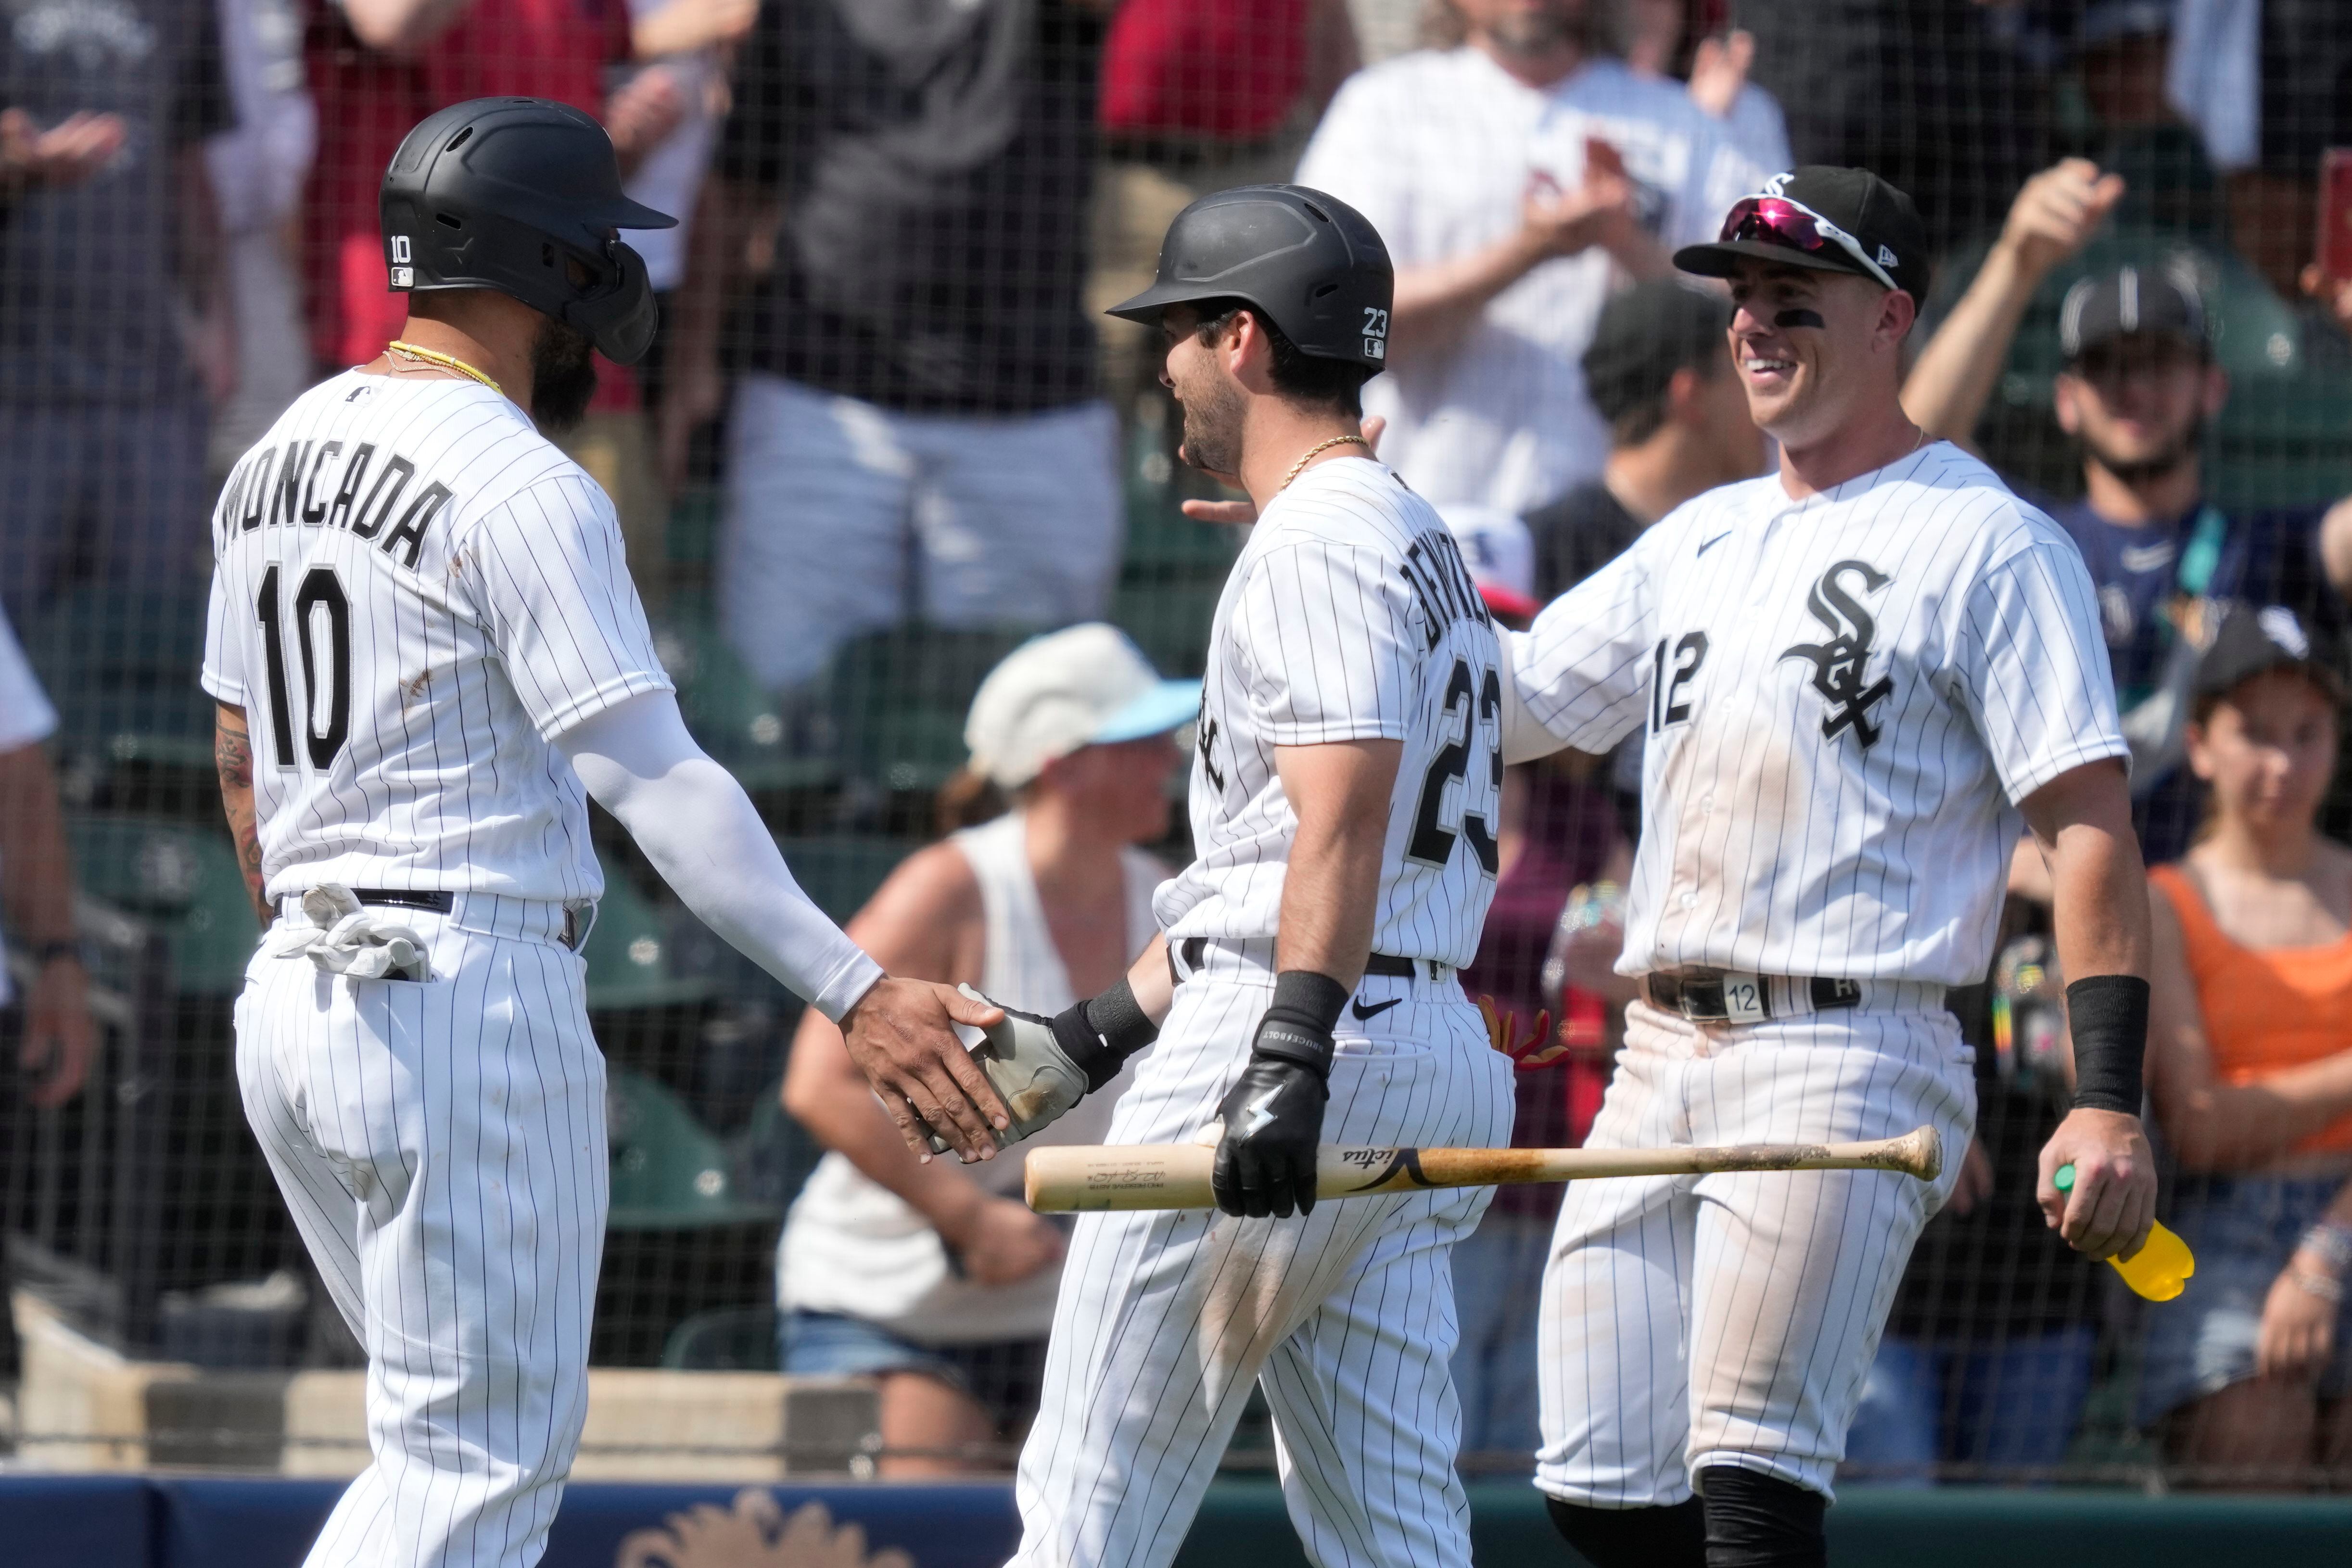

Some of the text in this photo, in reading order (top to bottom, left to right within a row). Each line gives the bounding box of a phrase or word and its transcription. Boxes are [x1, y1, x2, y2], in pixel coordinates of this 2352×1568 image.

[391, 235, 411, 263] 10
[1362, 307, 1387, 338] 23
[222, 438, 458, 572] MONCADA
[255, 560, 354, 778] 10
[1651, 627, 1712, 739] 12
[1403, 654, 1503, 880] 23
[1729, 984, 1758, 1012] 12
